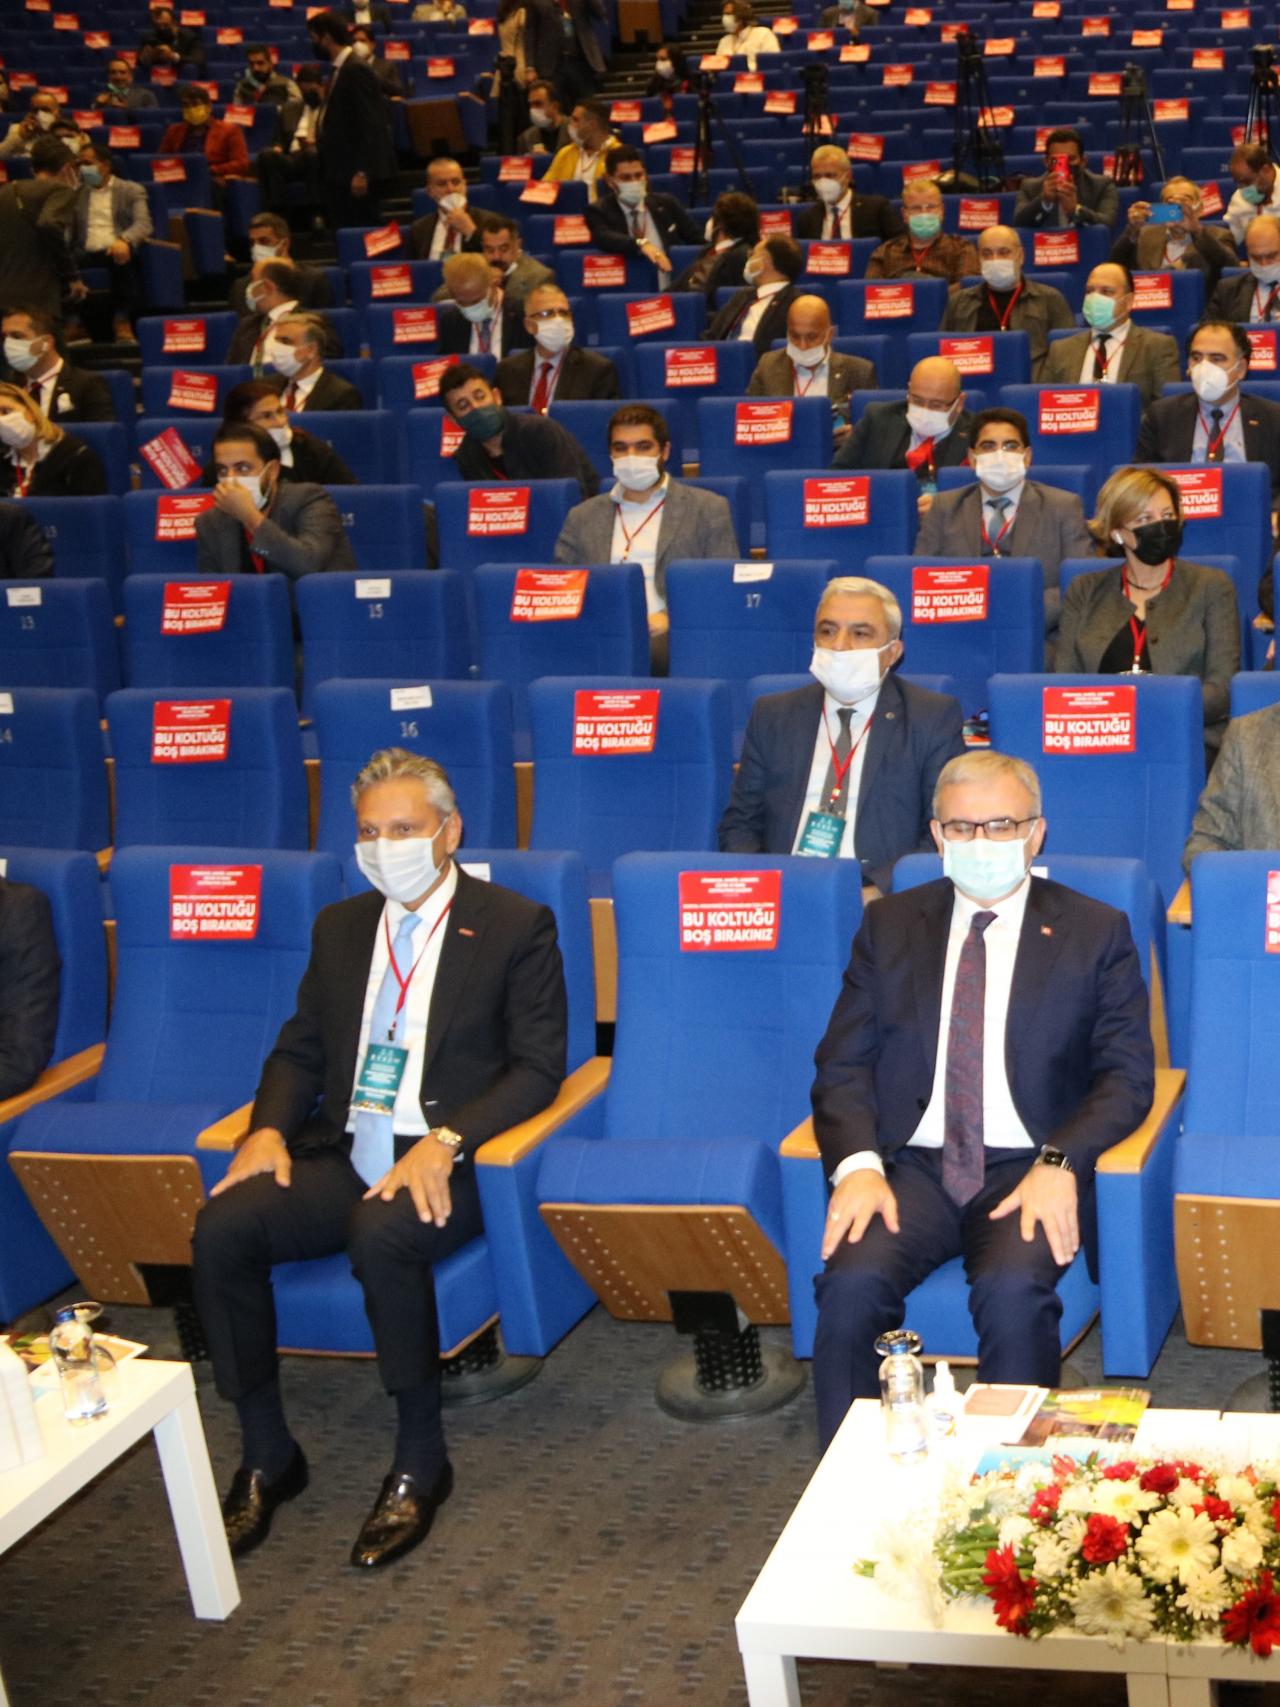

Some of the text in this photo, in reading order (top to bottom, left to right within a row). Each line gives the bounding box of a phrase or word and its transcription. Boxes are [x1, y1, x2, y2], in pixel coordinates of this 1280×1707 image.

[806, 500, 866, 513] BU KOLTUĞU
[514, 594, 580, 606] BU KOLTUĞU
[745, 593, 761, 608] 17
[914, 592, 983, 607] BU KOLTUĞU
[368, 603, 384, 619] 15
[913, 605, 983, 619] BOŞ BIRAKINIZ
[400, 721, 419, 738] 16
[576, 720, 652, 736] BU KOLTUĞU
[1045, 717, 1130, 734] BU KOLTUĞU
[155, 729, 225, 745] BU KOLTUĞU
[575, 736, 651, 750] BOŞ BIRAKINIZ
[1045, 734, 1130, 749] BOŞ BIRAKINIZ
[155, 743, 225, 759] BOŞ BIRAKINIZ
[173, 900, 255, 917] BU KOLTUĞU
[683, 908, 774, 927] BU KOLTUĞU
[173, 918, 254, 934] BOŞ BIRAKINIZ
[683, 927, 774, 945] BOŞ BIRAKINIZ
